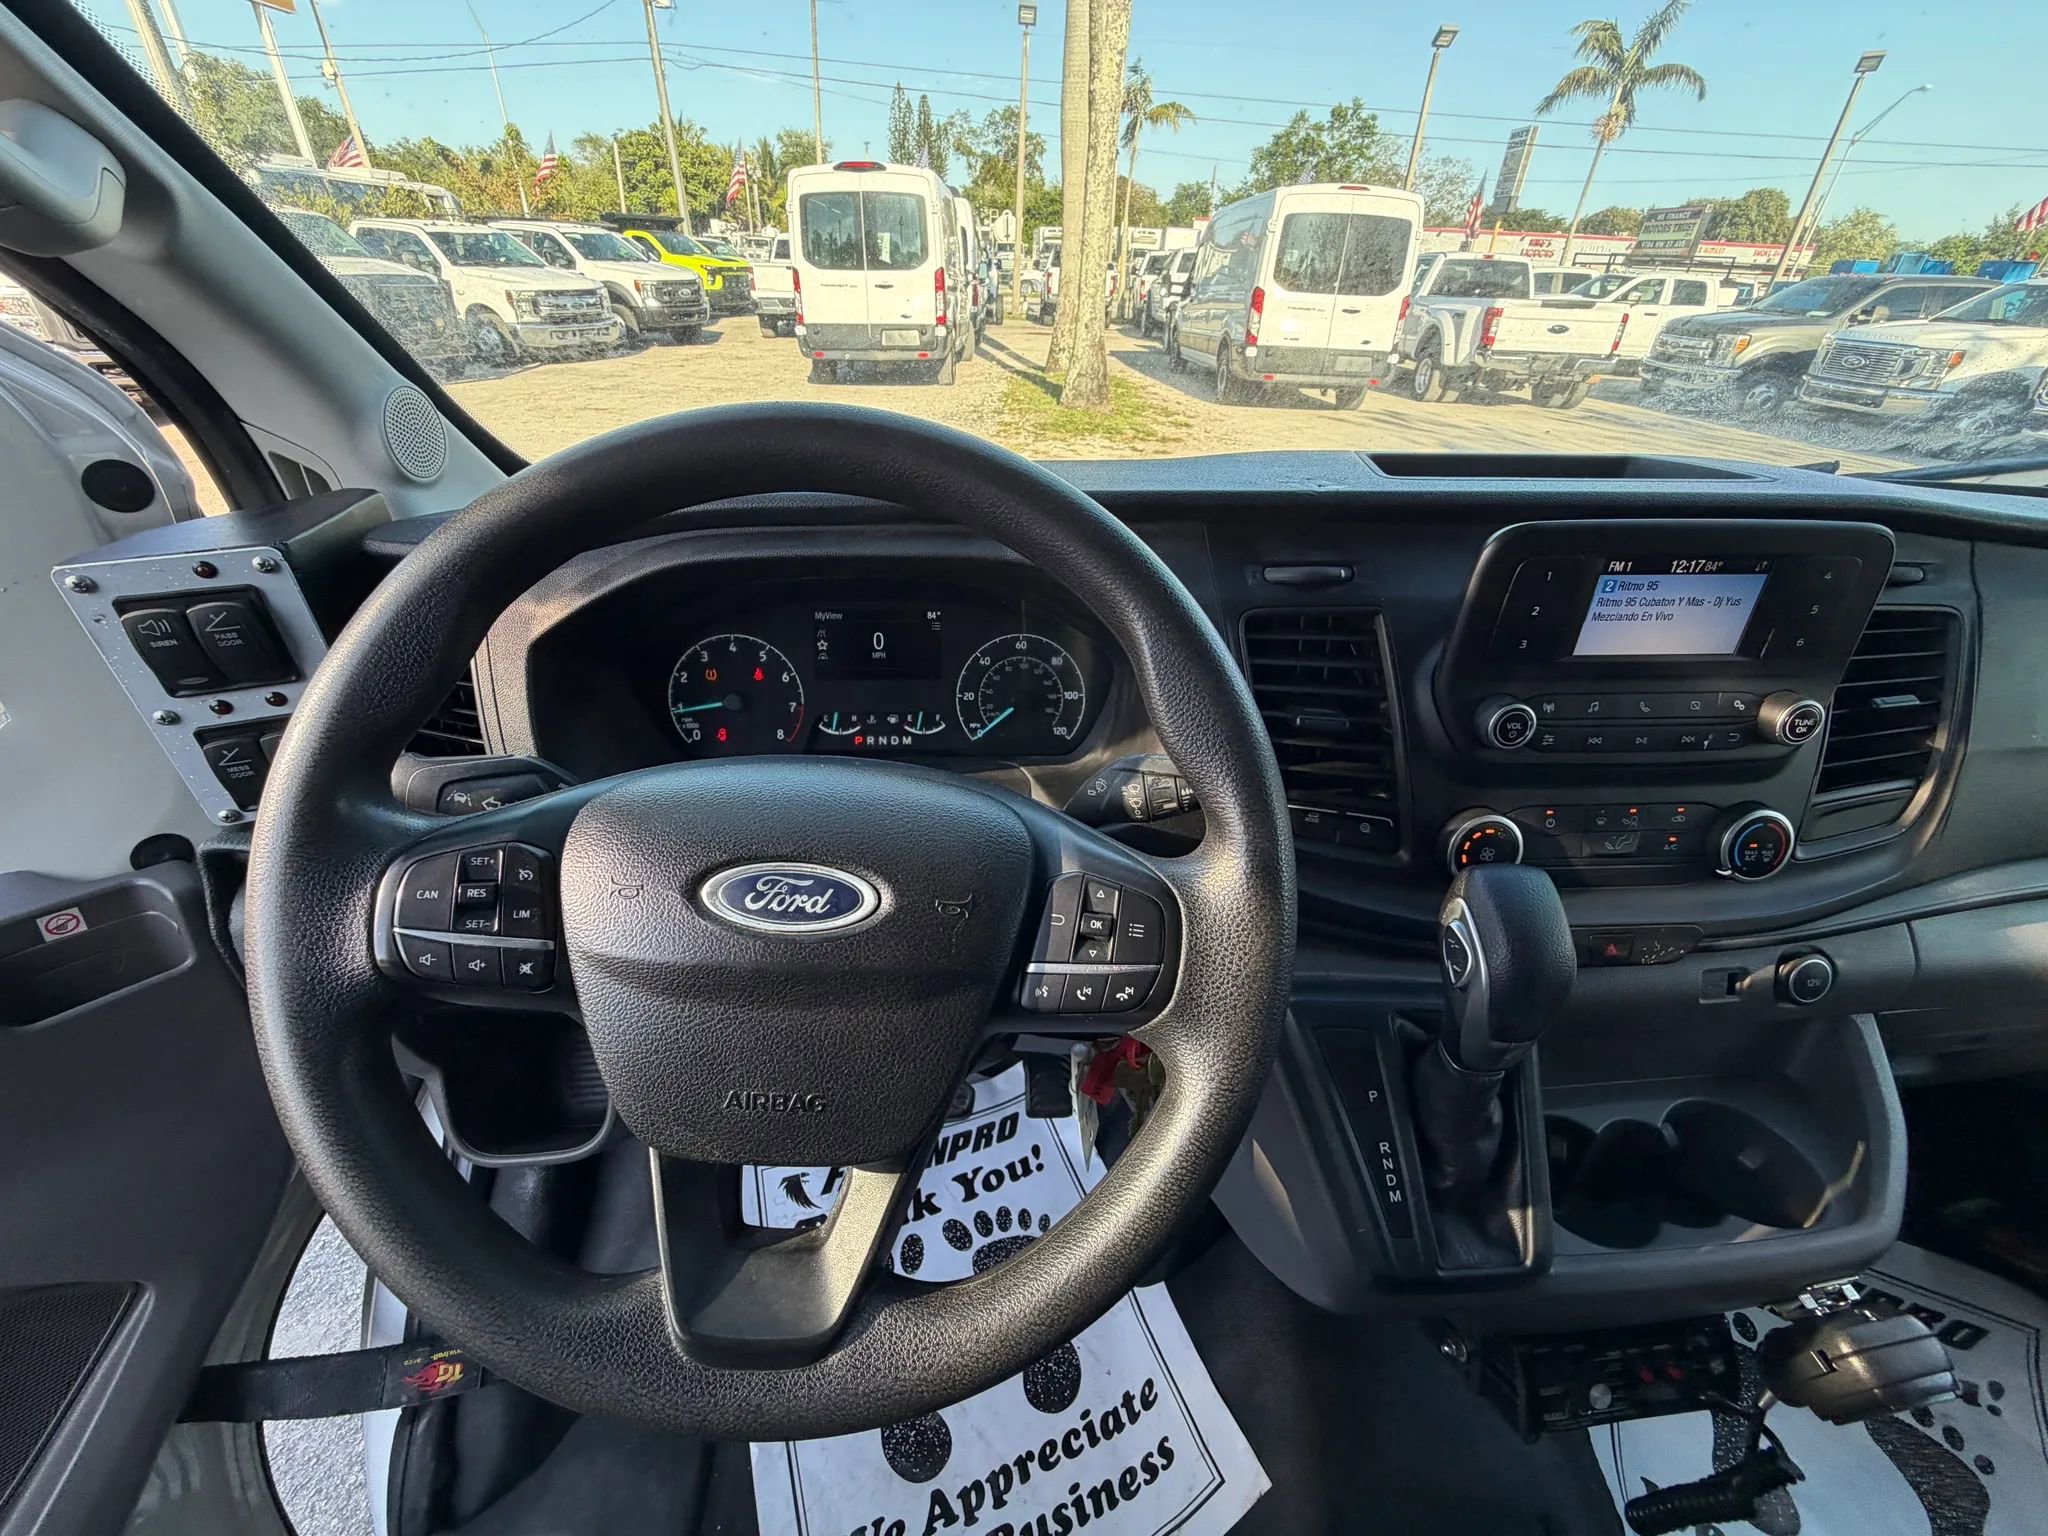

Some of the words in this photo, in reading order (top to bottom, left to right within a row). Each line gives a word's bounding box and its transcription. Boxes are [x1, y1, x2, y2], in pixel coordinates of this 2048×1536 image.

[1608, 561, 1623, 572] FM
[1627, 561, 1633, 572] 1
[1670, 559, 1705, 573] 12:17
[1823, 571, 1832, 580] 4
[1617, 581, 1645, 592] Ritmo
[1646, 581, 1660, 591] 95
[1596, 597, 1623, 607] Ritmo
[1624, 597, 1637, 607] 95
[1638, 597, 1675, 607] Cubaton
[1677, 597, 1684, 607] Y
[1685, 597, 1705, 607] Mas
[1713, 597, 1723, 608] Dj
[1725, 596, 1742, 607] Yus
[1531, 606, 1540, 616] 2
[1809, 605, 1819, 615] 5
[814, 612, 843, 621] MyView
[1591, 611, 1639, 622] Mezclando
[1640, 611, 1653, 621] En
[1655, 611, 1674, 621] Vivo
[150, 639, 178, 648] SIREN
[873, 632, 884, 650] 0
[1015, 641, 1027, 650] 60
[1519, 640, 1528, 649] 3
[1795, 638, 1805, 648] 6
[729, 642, 737, 652] 4
[701, 651, 708, 662] 3
[760, 651, 767, 662] 5
[979, 656, 991, 666] 40
[1051, 656, 1063, 666] 80
[680, 672, 688, 683] 2
[782, 672, 790, 683] 6
[963, 692, 974, 701] 20
[1064, 691, 1078, 700] 100
[788, 702, 797, 713] 7
[693, 729, 701, 740] 0
[777, 729, 784, 740] 8
[1053, 727, 1067, 736] 120
[855, 736, 863, 745] P
[867, 736, 875, 745] R
[879, 736, 887, 745] N
[891, 736, 899, 745] D
[902, 736, 912, 745] M
[416, 890, 439, 899] CAN
[467, 888, 487, 898] RES
[745, 875, 834, 914] Ford
[513, 909, 530, 919] LIM
[1090, 919, 1103, 930] OK
[723, 1090, 827, 1112] AIRBAG
[1368, 1090, 1378, 1102] P
[1379, 1142, 1391, 1154] R
[1382, 1158, 1394, 1170] N
[952, 1144, 1044, 1203] You!
[1386, 1174, 1397, 1187] D
[1389, 1189, 1402, 1203] M
[922, 1377, 1159, 1536] Appreciate
